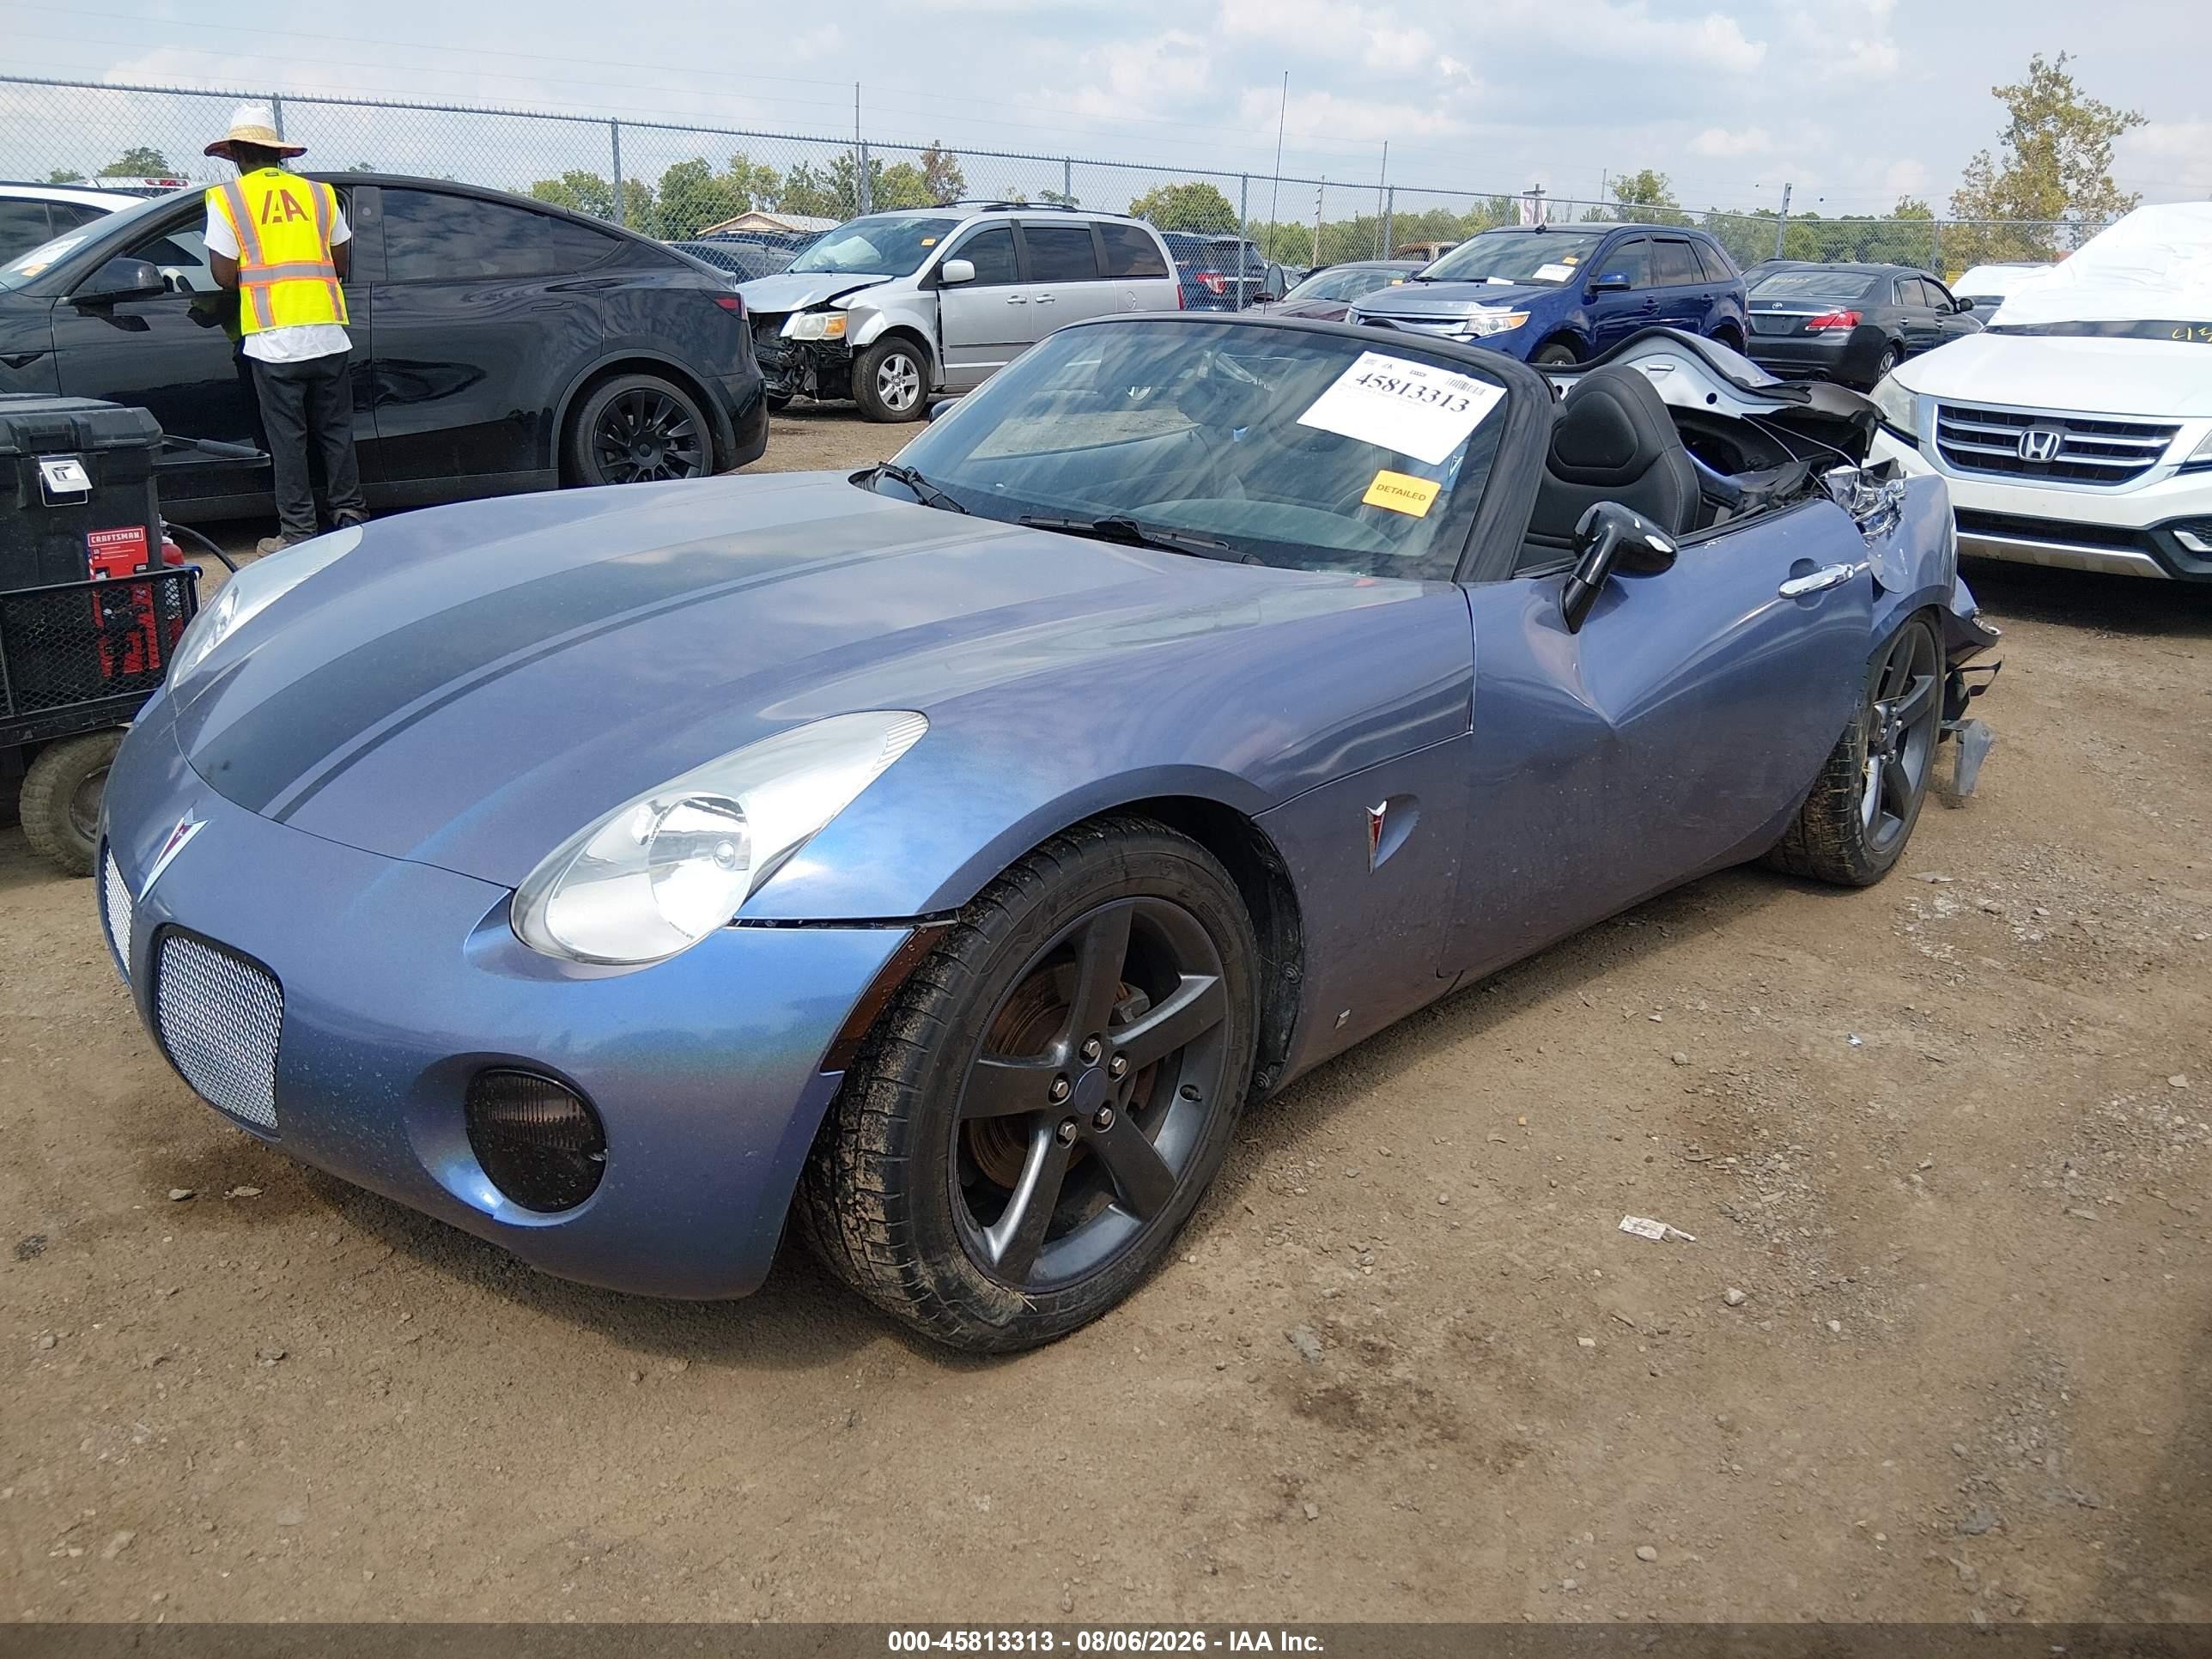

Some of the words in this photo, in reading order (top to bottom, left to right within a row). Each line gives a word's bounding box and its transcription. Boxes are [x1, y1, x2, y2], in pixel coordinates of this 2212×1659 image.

[1355, 373, 1470, 412] 45813313
[1376, 483, 1426, 501] DETAILED
[91, 532, 141, 544] CRAFTSMAN
